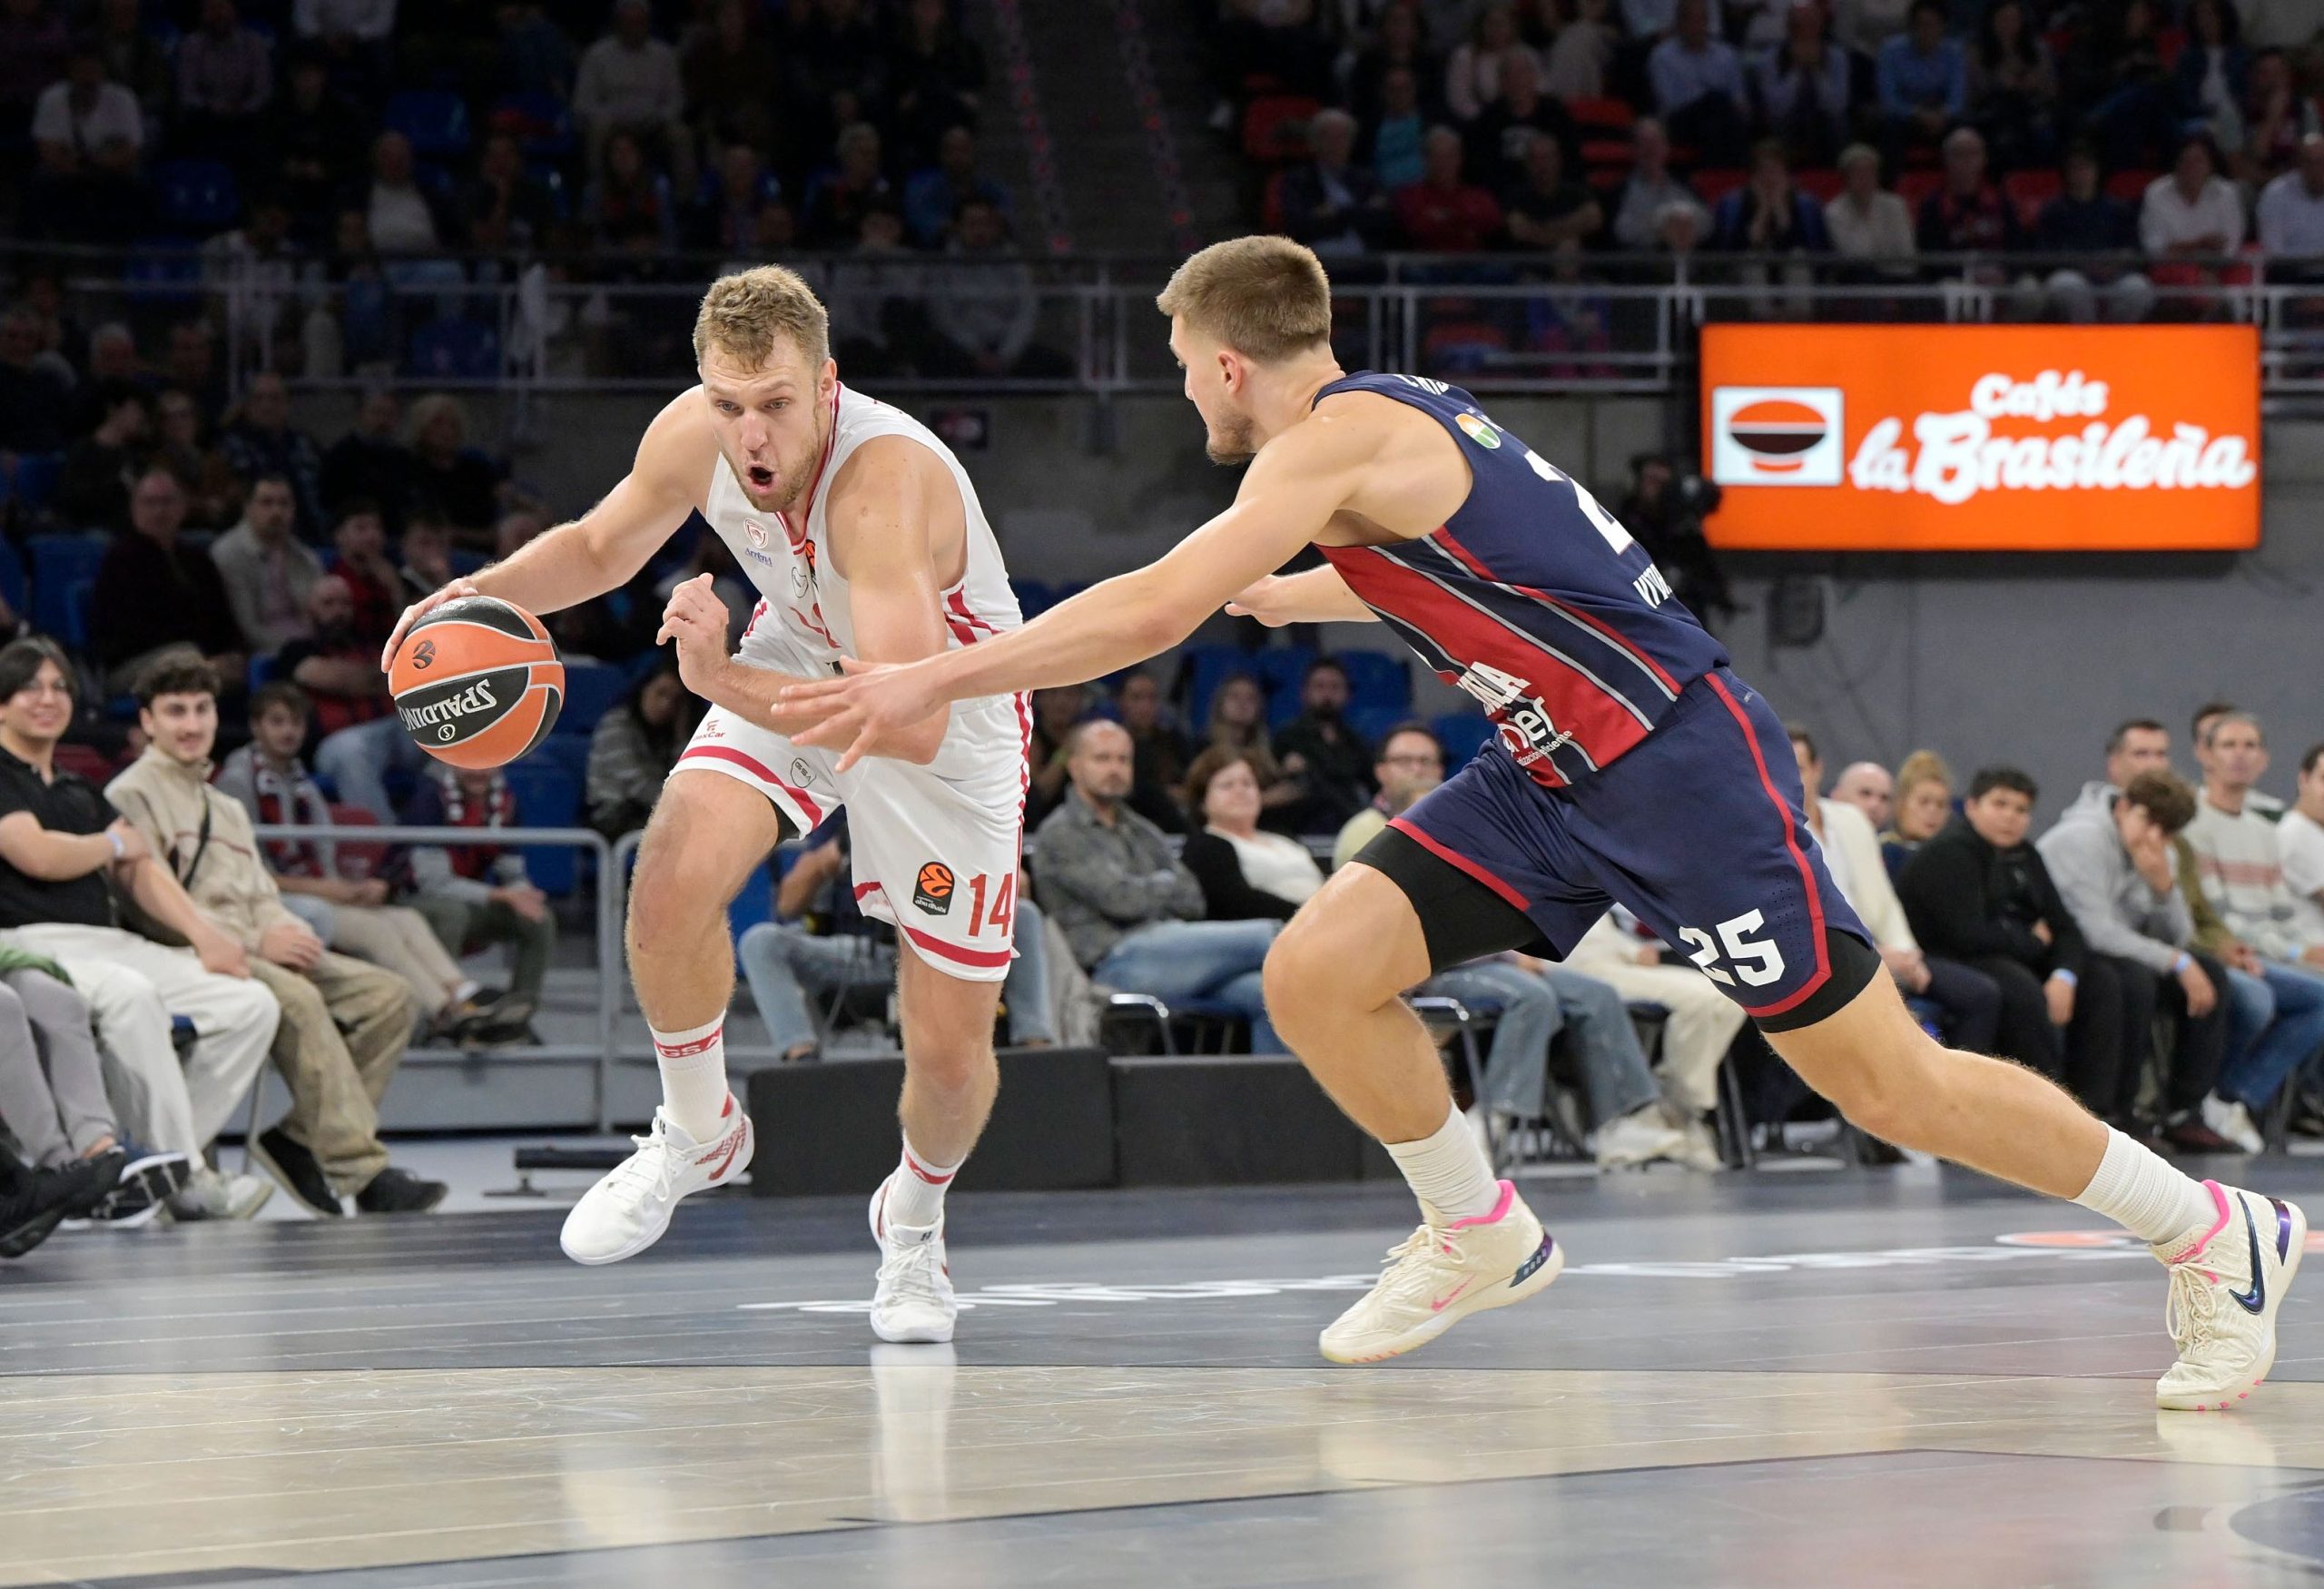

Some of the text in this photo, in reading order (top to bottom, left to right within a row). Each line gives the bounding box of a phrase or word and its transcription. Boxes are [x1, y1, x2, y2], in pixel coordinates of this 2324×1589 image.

[1971, 370, 2108, 421] Cafés
[1849, 410, 2256, 504] la Brasileña
[398, 678, 497, 732] SPALDING
[968, 873, 1012, 938] 14
[1679, 908, 1786, 987] 25
